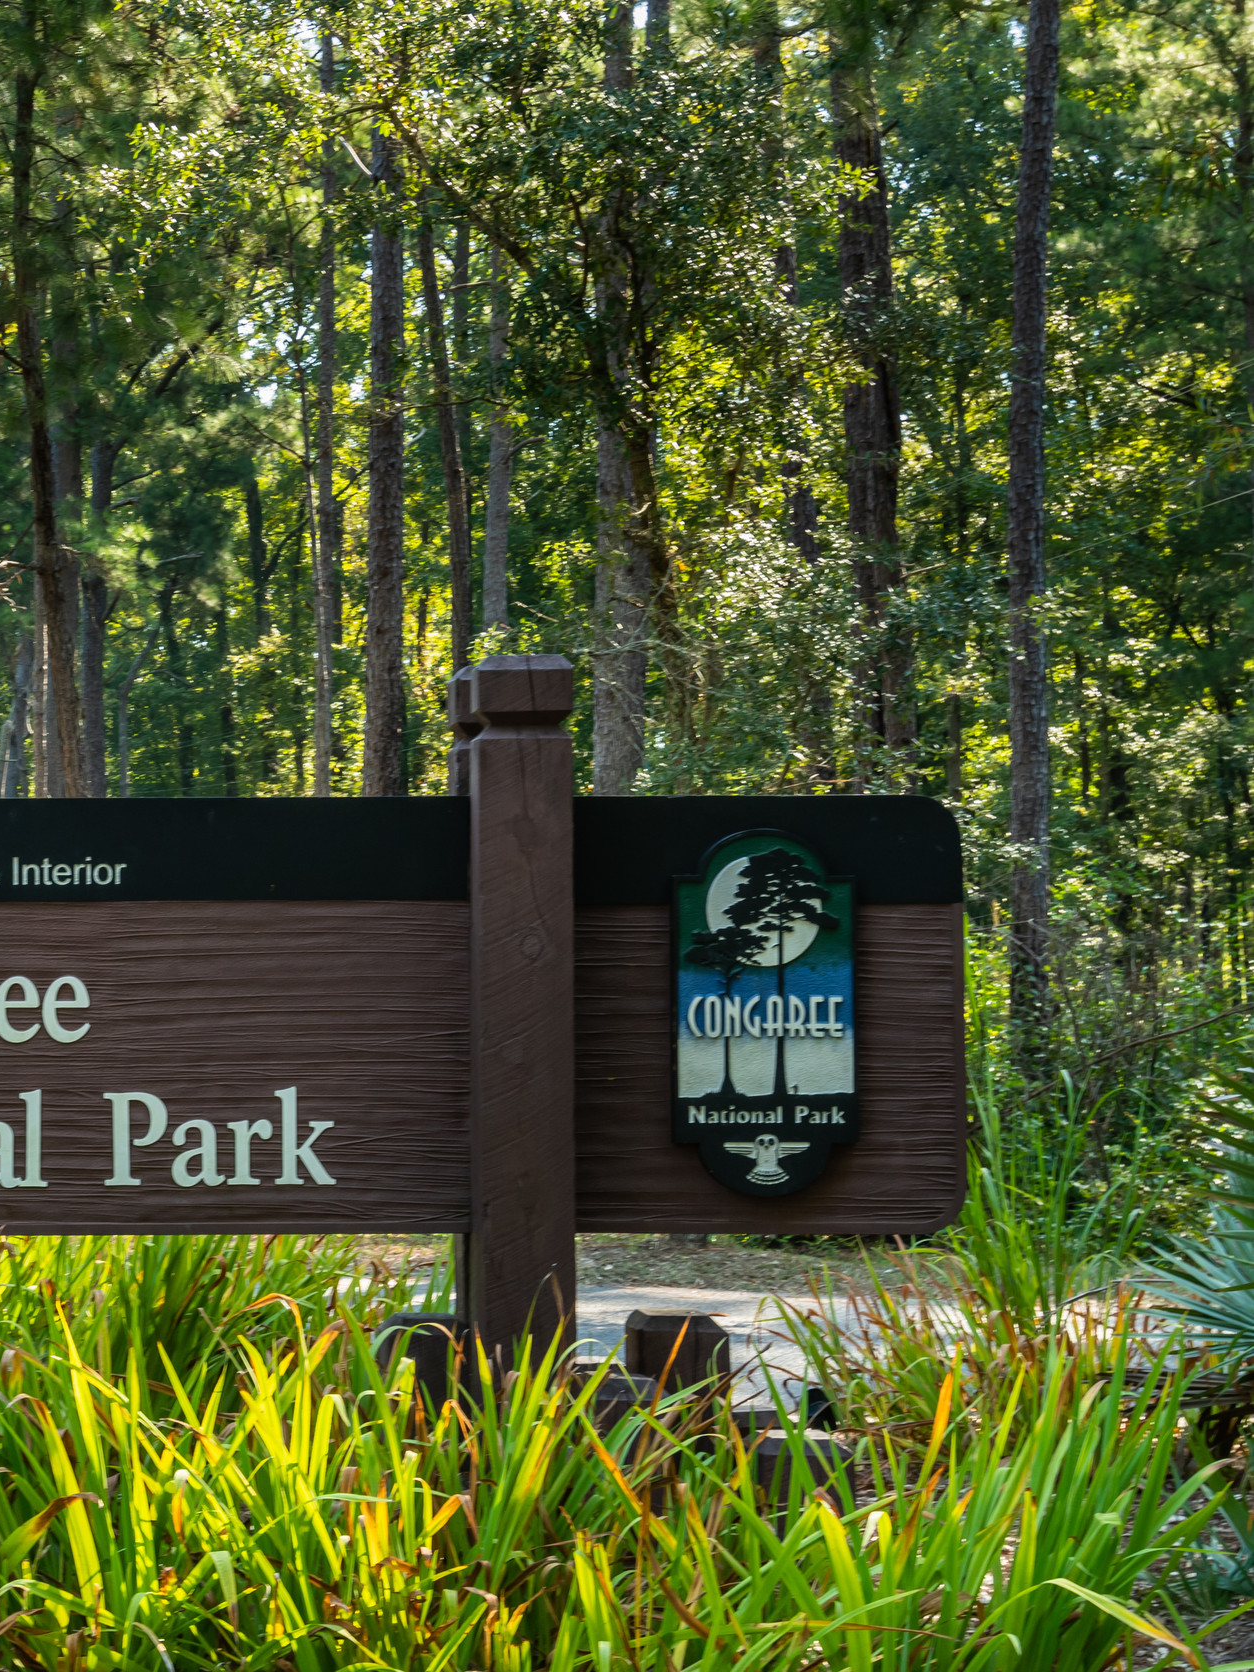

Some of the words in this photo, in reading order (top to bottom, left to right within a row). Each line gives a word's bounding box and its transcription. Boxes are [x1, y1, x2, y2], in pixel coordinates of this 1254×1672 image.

[12, 856, 127, 886] Interior
[687, 995, 844, 1038] CONGAREE
[688, 1105, 783, 1124] National
[794, 1105, 846, 1124] Park
[102, 1085, 337, 1188] Park
